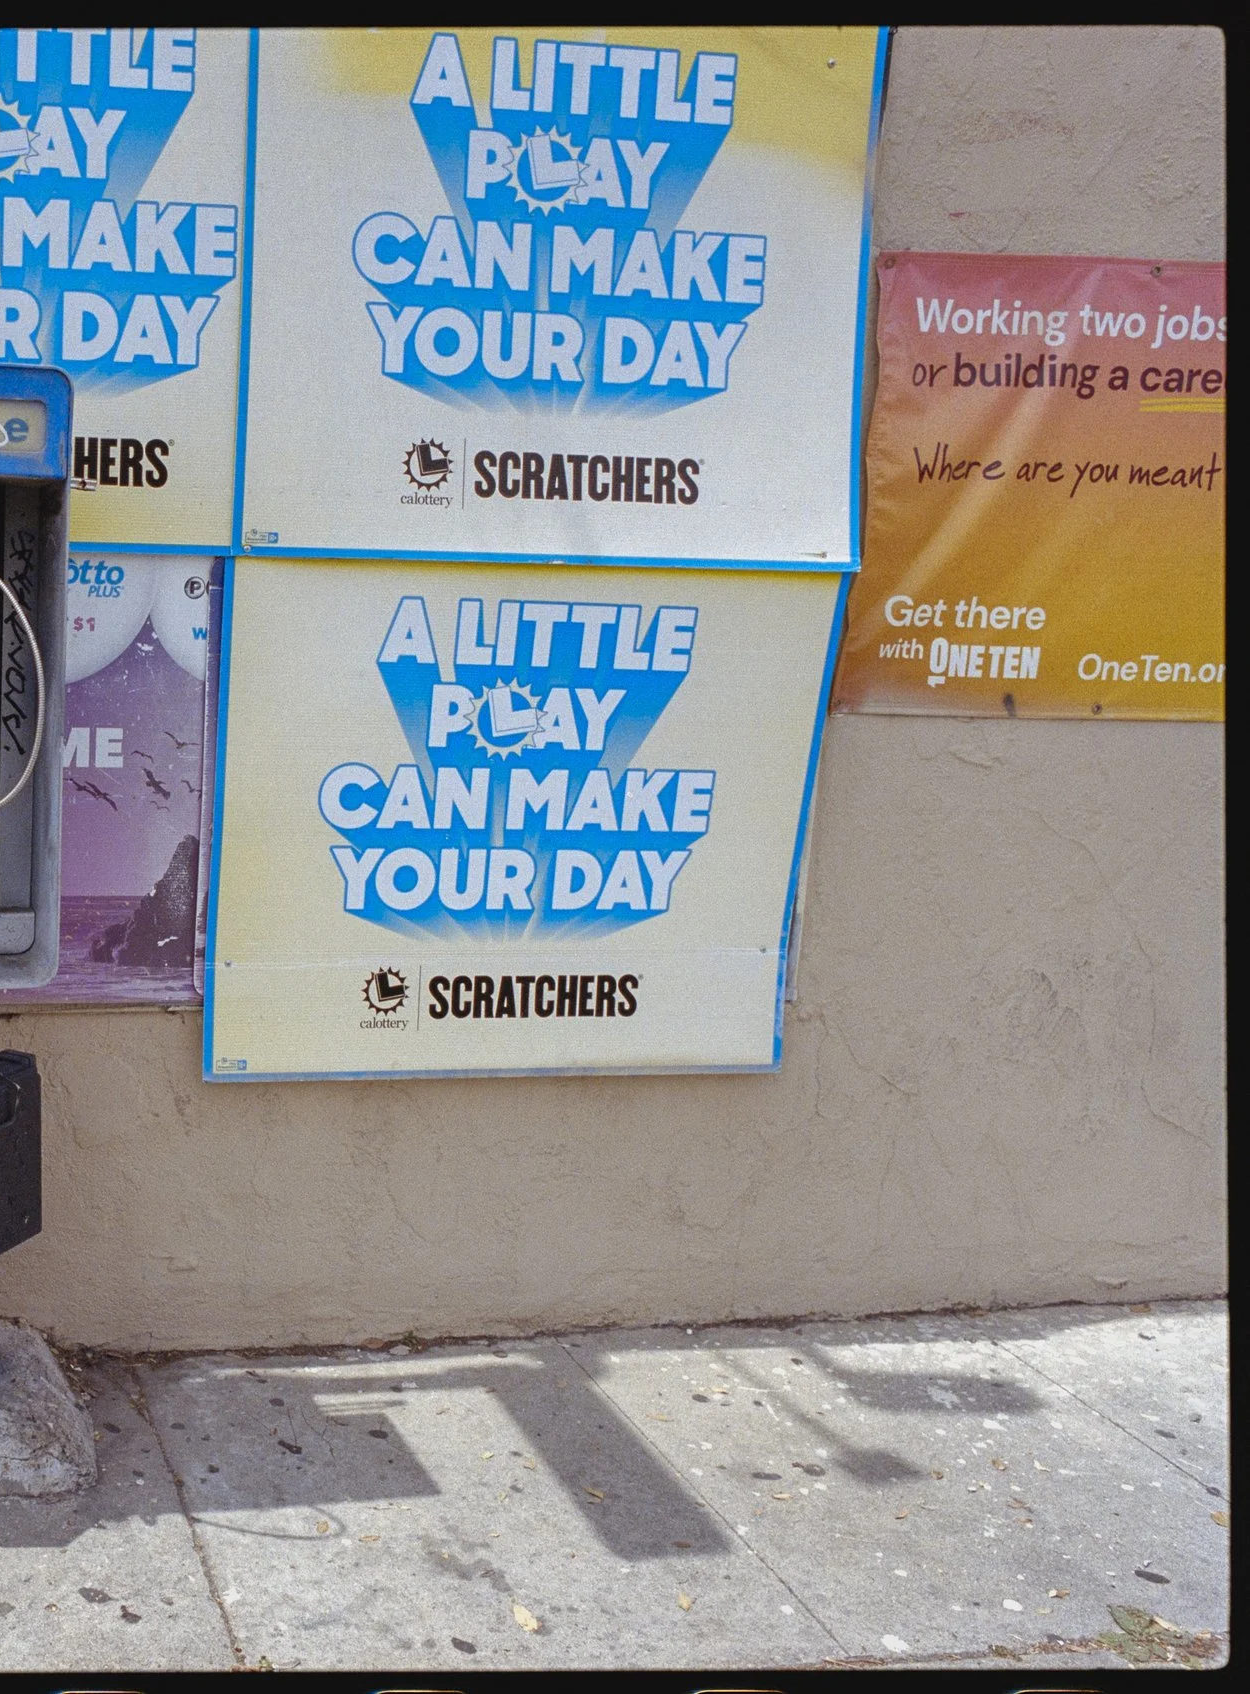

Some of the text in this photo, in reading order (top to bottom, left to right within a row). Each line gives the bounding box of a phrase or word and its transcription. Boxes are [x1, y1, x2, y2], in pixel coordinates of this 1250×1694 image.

[411, 33, 739, 126] A LITTLE
[466, 128, 670, 210] PLAY
[2, 196, 238, 279] MAKE
[352, 212, 768, 305] CAN MAKE
[62, 291, 220, 367] DAY
[366, 302, 748, 391] YOUR DAY
[915, 297, 1228, 349] Working two jobs
[912, 361, 947, 388] or
[953, 352, 1100, 399] building
[1108, 366, 1129, 391] a
[400, 491, 454, 509] calottery
[913, 442, 1224, 498] Where are you meant
[88, 585, 121, 598] PLUS
[884, 595, 1047, 631] Get there
[74, 616, 96, 632] $1
[378, 596, 699, 672] A LITTLE
[879, 638, 924, 660] with
[1077, 653, 1225, 683] OneTen.or
[428, 681, 627, 752] PLAY
[318, 762, 717, 833] CAN MAKE
[329, 845, 693, 912] YOUR DAY
[359, 1016, 410, 1032] calottery
